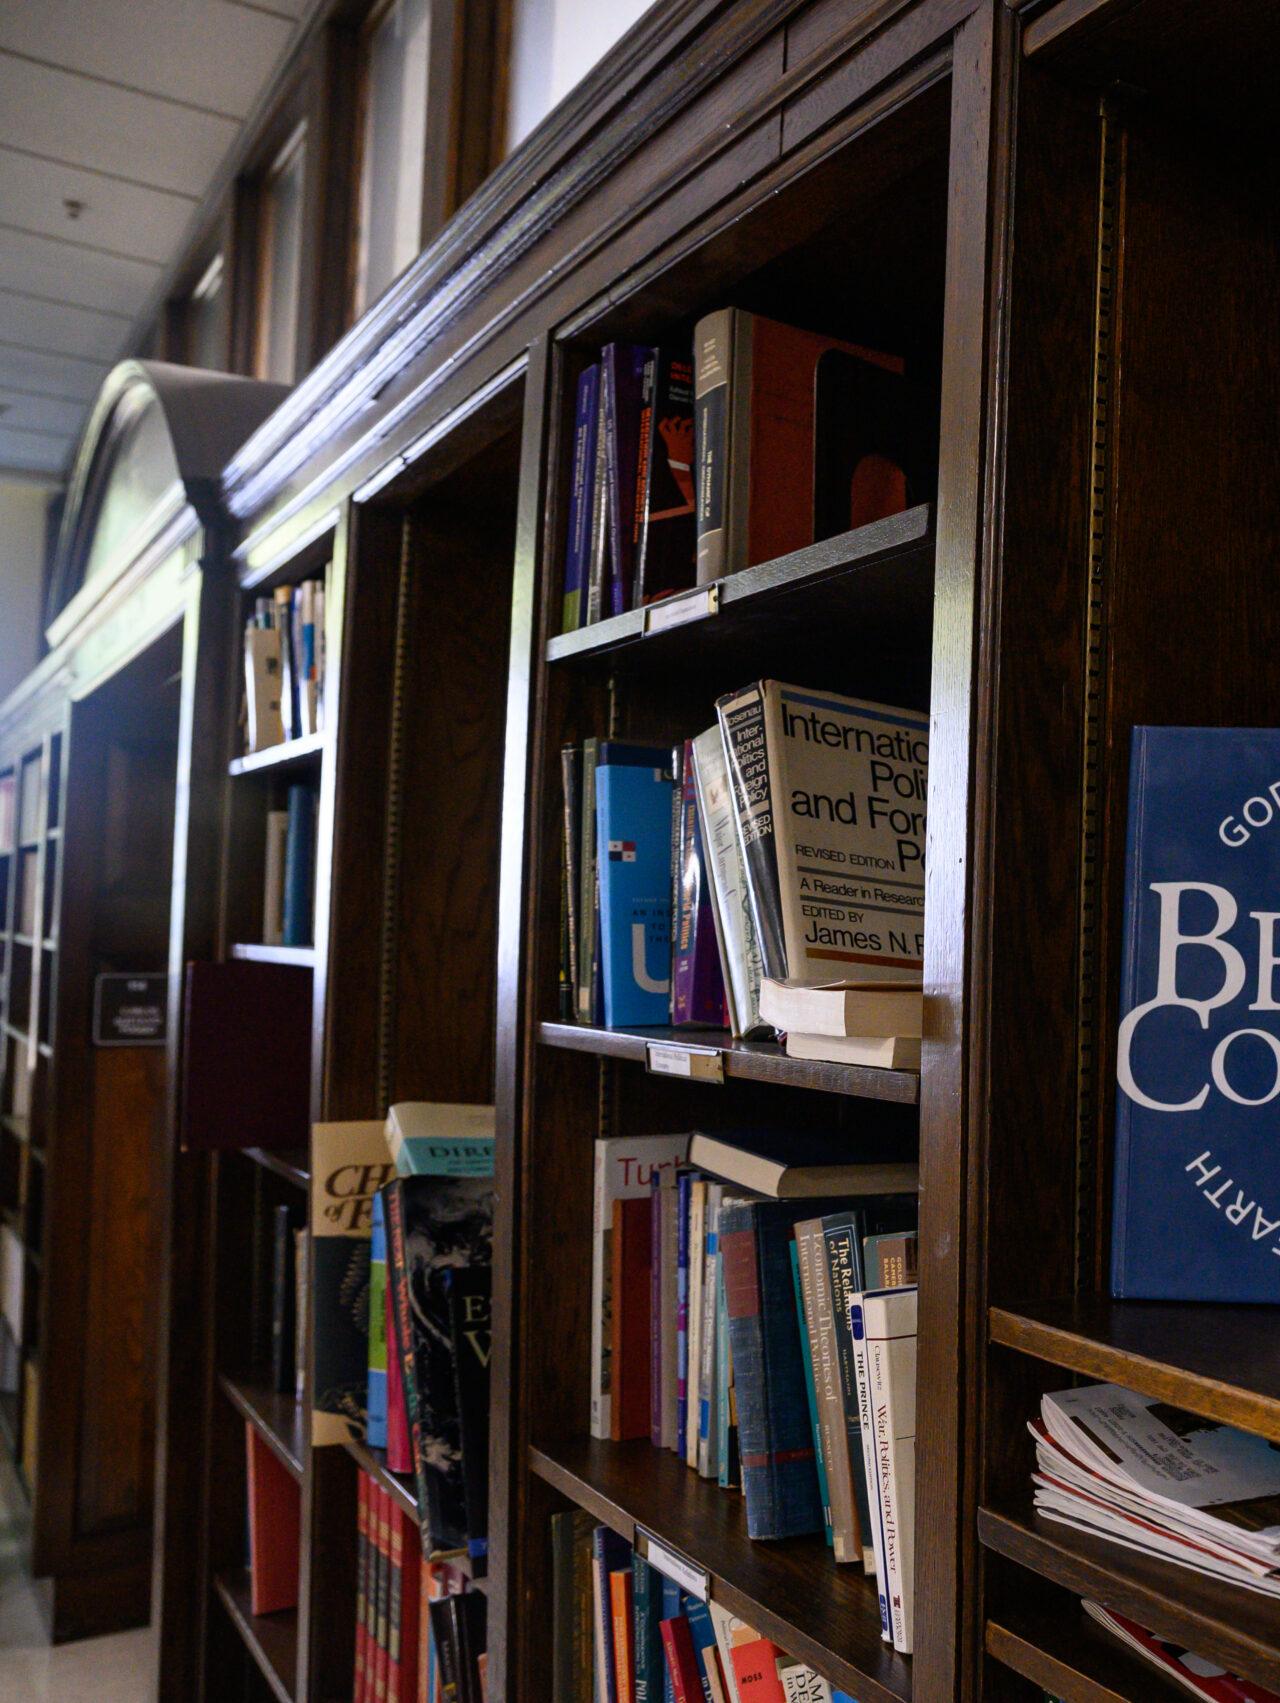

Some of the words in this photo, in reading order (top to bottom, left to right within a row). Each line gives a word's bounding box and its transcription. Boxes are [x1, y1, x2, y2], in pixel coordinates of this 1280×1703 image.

[727, 705, 761, 726] osenau
[737, 725, 763, 741] Inter-
[746, 760, 766, 777] and
[735, 774, 768, 796] Foeign
[739, 787, 768, 808] Plicy
[791, 790, 857, 826] and
[795, 844, 846, 863] REVISED
[850, 853, 896, 870] EDITION
[800, 877, 811, 891] A
[814, 879, 859, 898] Reader
[861, 885, 871, 900] in
[802, 905, 846, 922] EDITED
[850, 908, 864, 923] BY
[805, 921, 882, 951] James
[888, 931, 911, 955] N.
[324, 1198, 347, 1224] of
[838, 1238, 849, 1266] The
[813, 1232, 827, 1309] Economic
[831, 1259, 842, 1313] Nations
[799, 1234, 816, 1336] International
[809, 1338, 820, 1393] Politics
[817, 1310, 835, 1379] Theories
[856, 1351, 865, 1377] THE
[874, 1345, 882, 1391] Clausewitz
[825, 1381, 837, 1402] of
[859, 1379, 869, 1430] PRINCE
[877, 1404, 888, 1438] War,
[880, 1440, 890, 1493] Politics,
[884, 1495, 893, 1525] and
[886, 1527, 898, 1574] Power
[635, 1679, 648, 1703] POL
[786, 1677, 795, 1690] in
